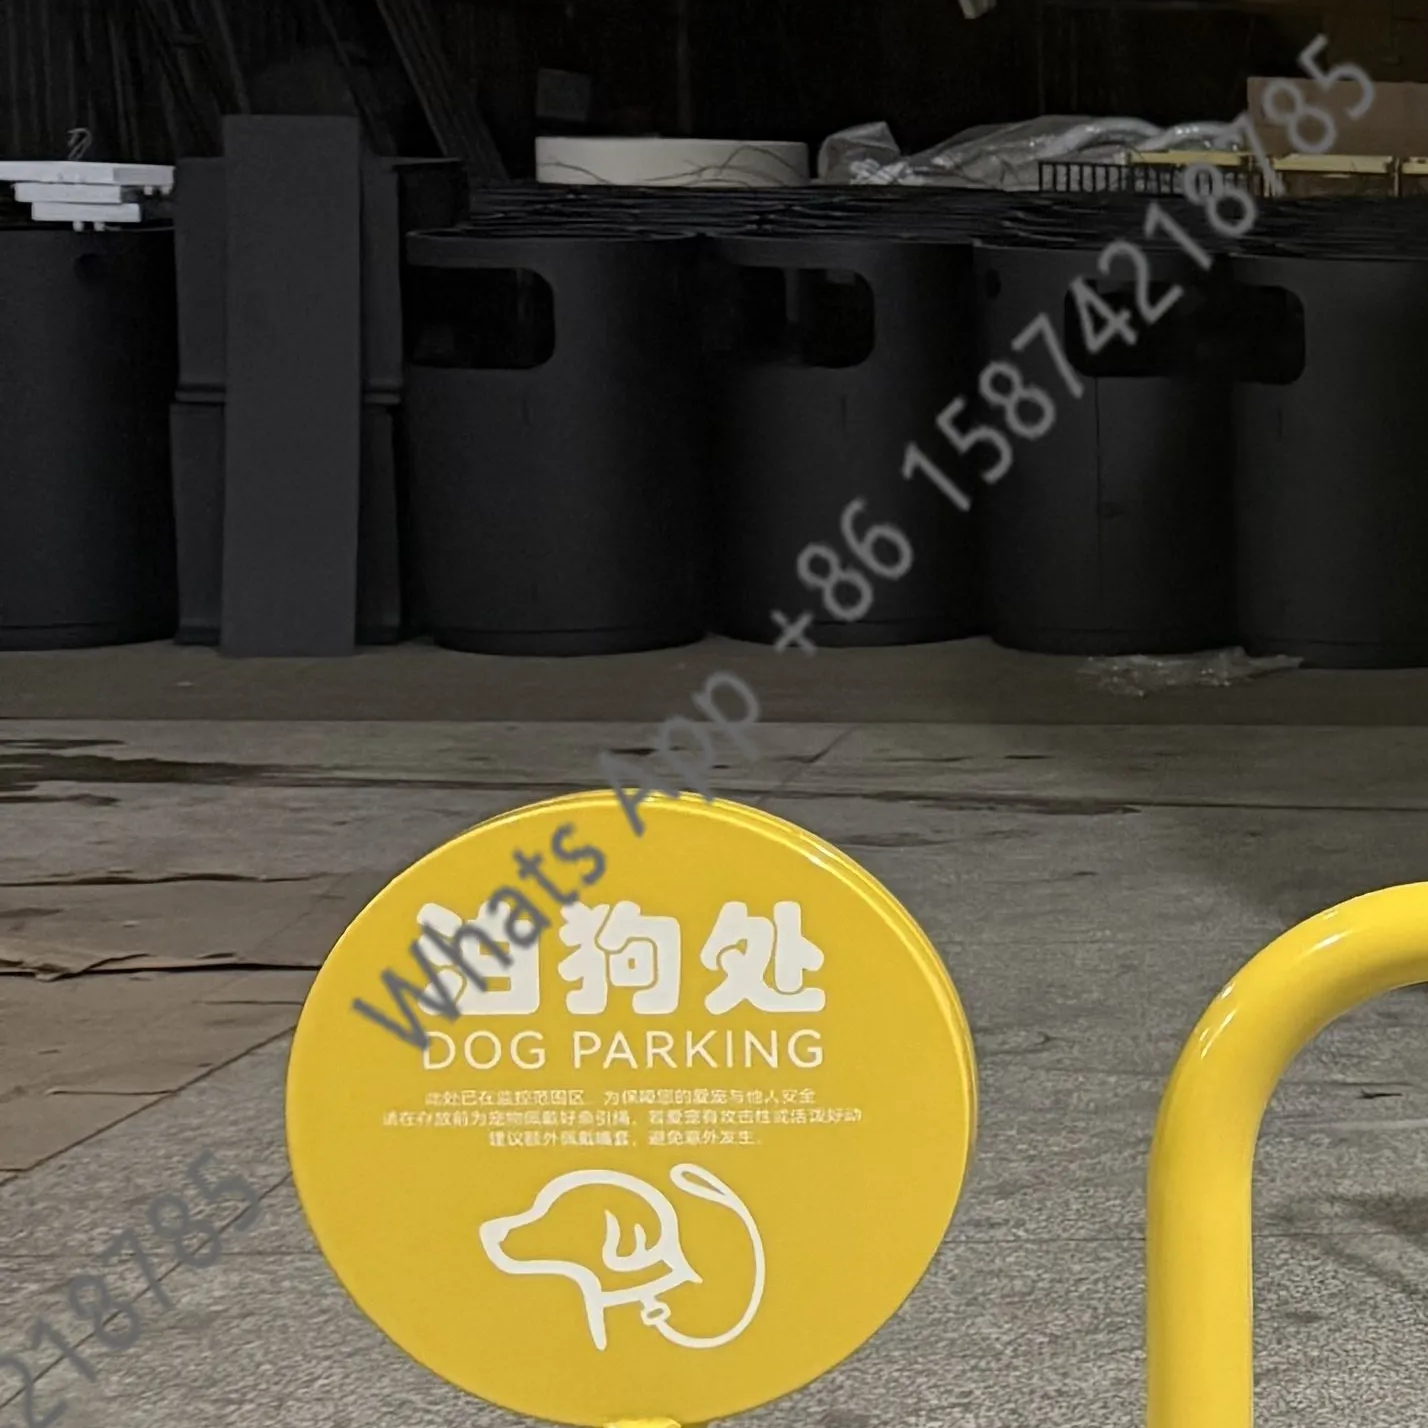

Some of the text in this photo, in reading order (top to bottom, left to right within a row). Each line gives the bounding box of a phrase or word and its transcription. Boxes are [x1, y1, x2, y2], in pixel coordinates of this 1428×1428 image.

[417, 901, 826, 1015] 泊狗处
[422, 1029, 825, 1071] DOG PARKING
